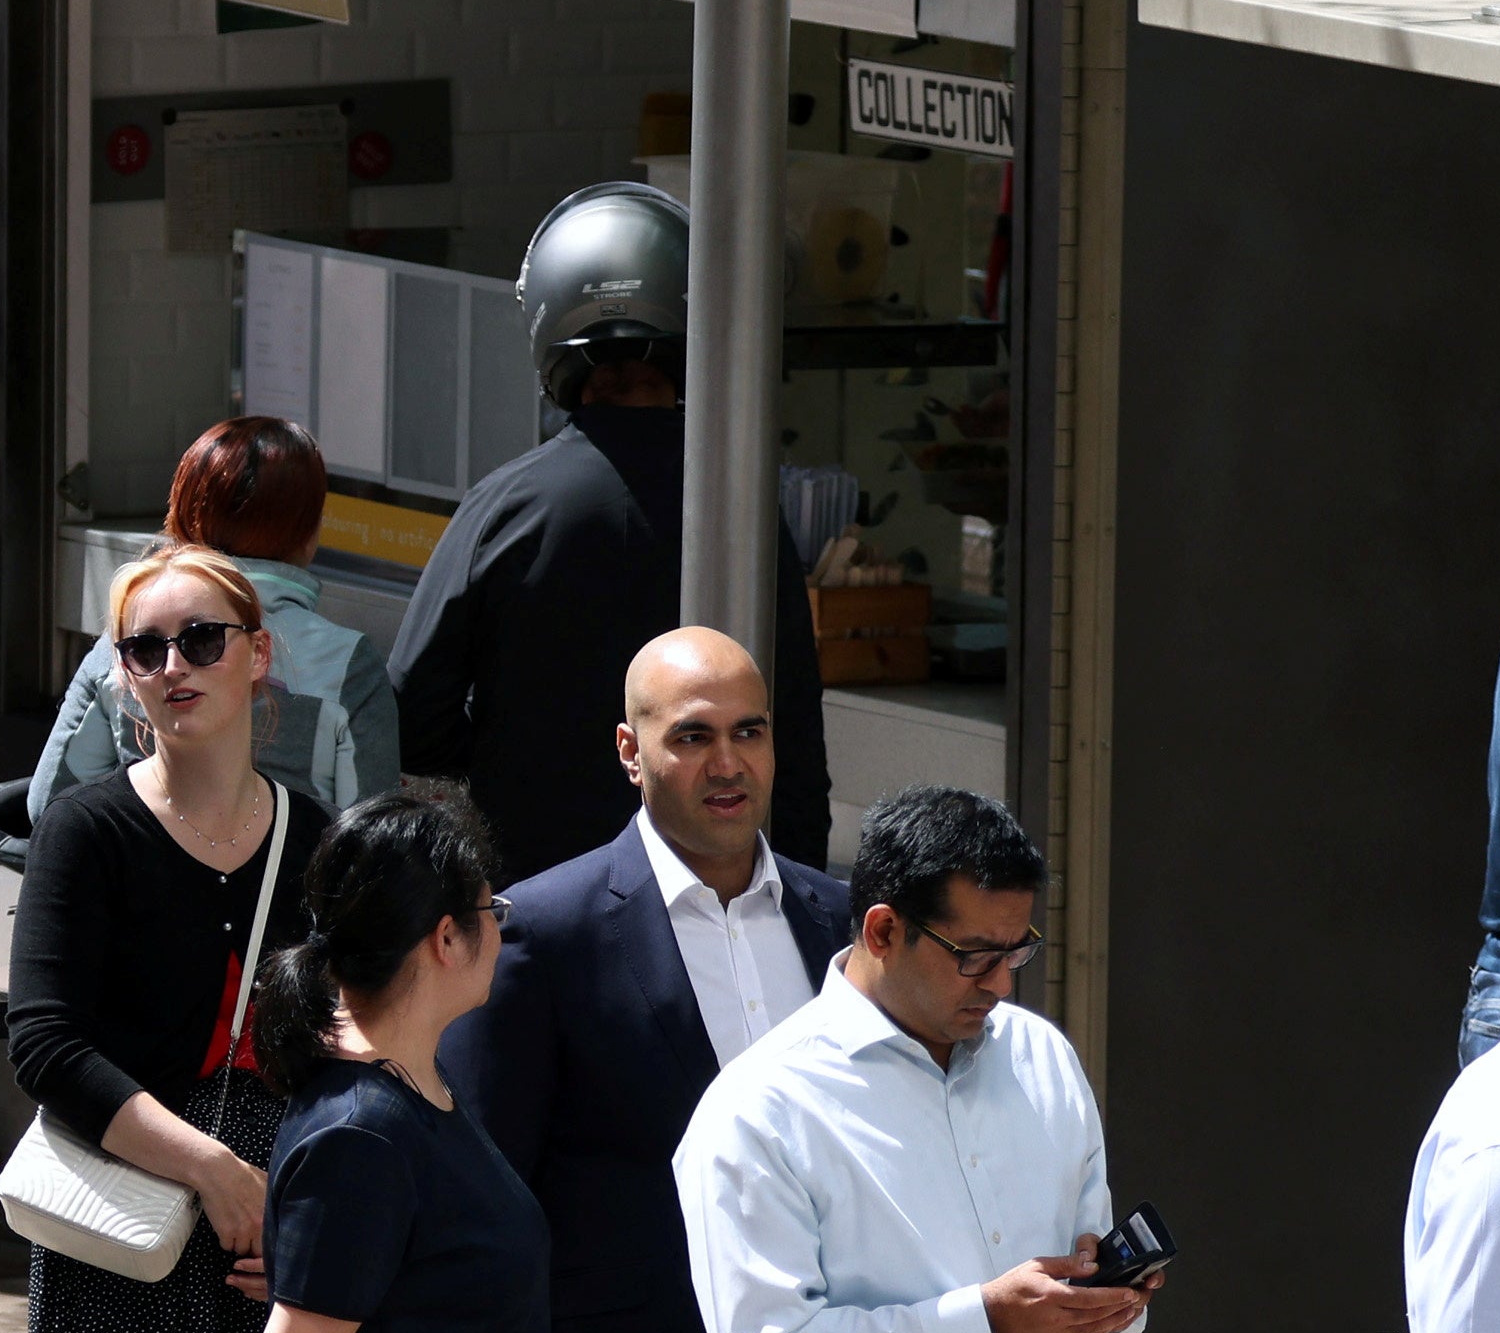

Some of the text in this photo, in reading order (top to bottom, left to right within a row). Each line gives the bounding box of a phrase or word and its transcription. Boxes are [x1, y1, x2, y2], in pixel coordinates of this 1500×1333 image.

[858, 69, 1014, 146] COLLECTION
[581, 279, 643, 294] LS2
[592, 291, 633, 300] STROBE
